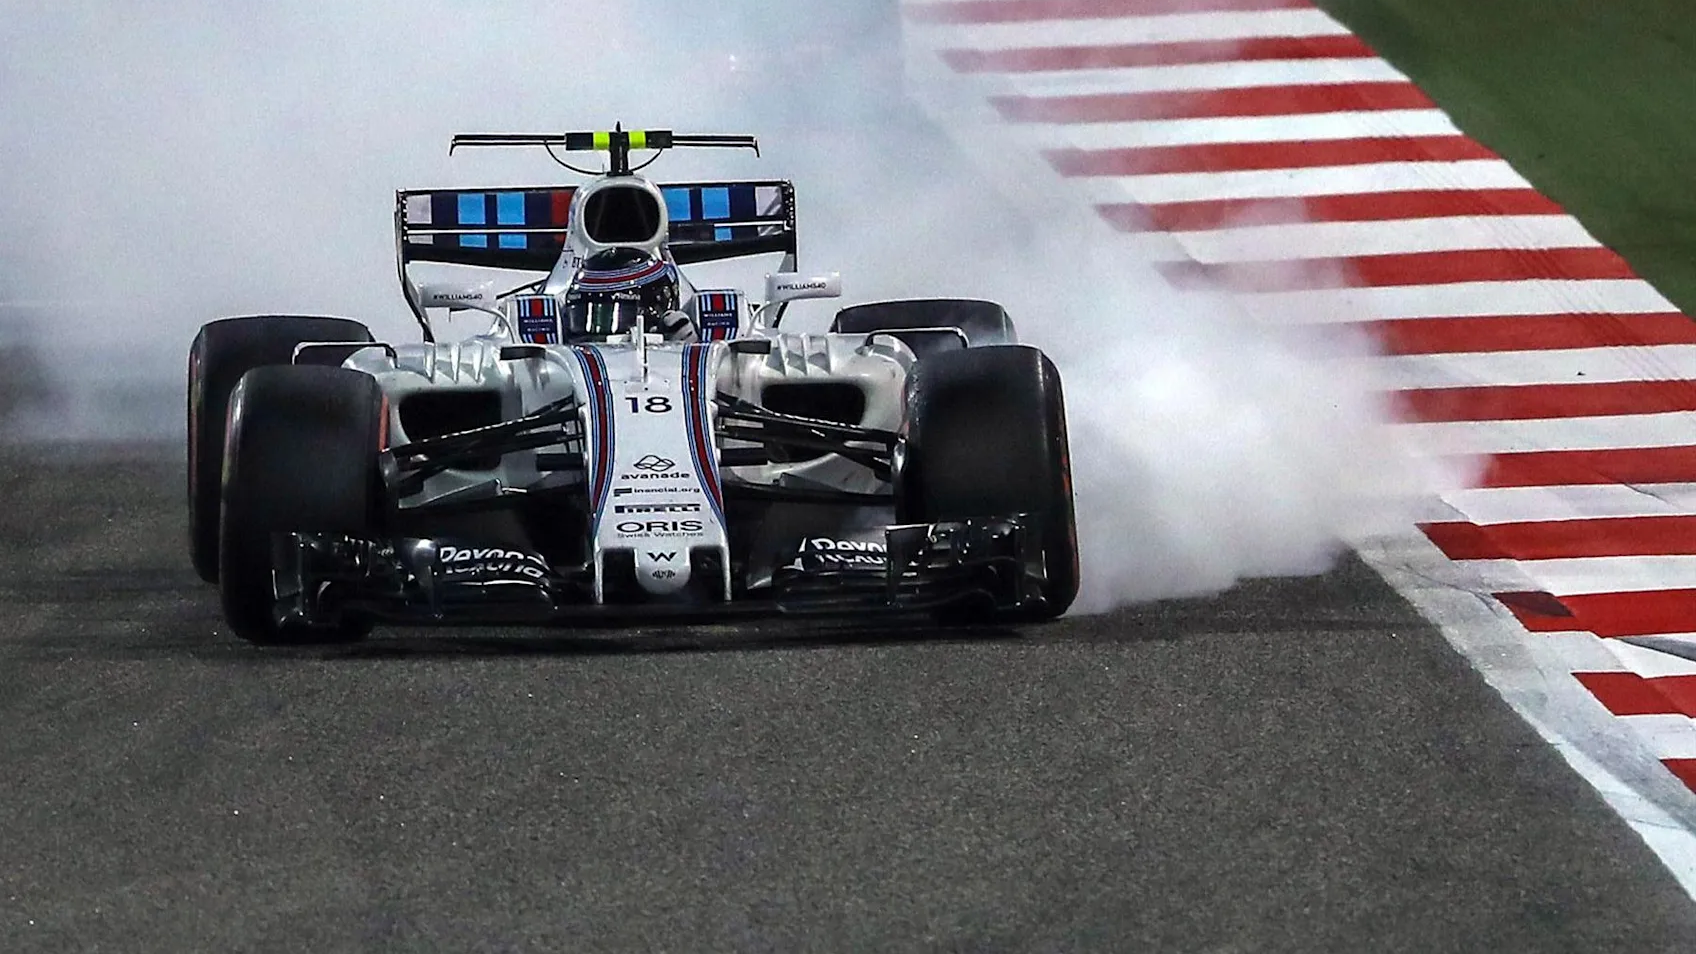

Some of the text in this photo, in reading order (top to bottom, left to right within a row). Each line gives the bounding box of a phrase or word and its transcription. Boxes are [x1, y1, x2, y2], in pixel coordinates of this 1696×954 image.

[625, 396, 673, 414] 18
[621, 471, 691, 480] avanade
[616, 520, 703, 533] ORIS
[647, 552, 677, 562] W
